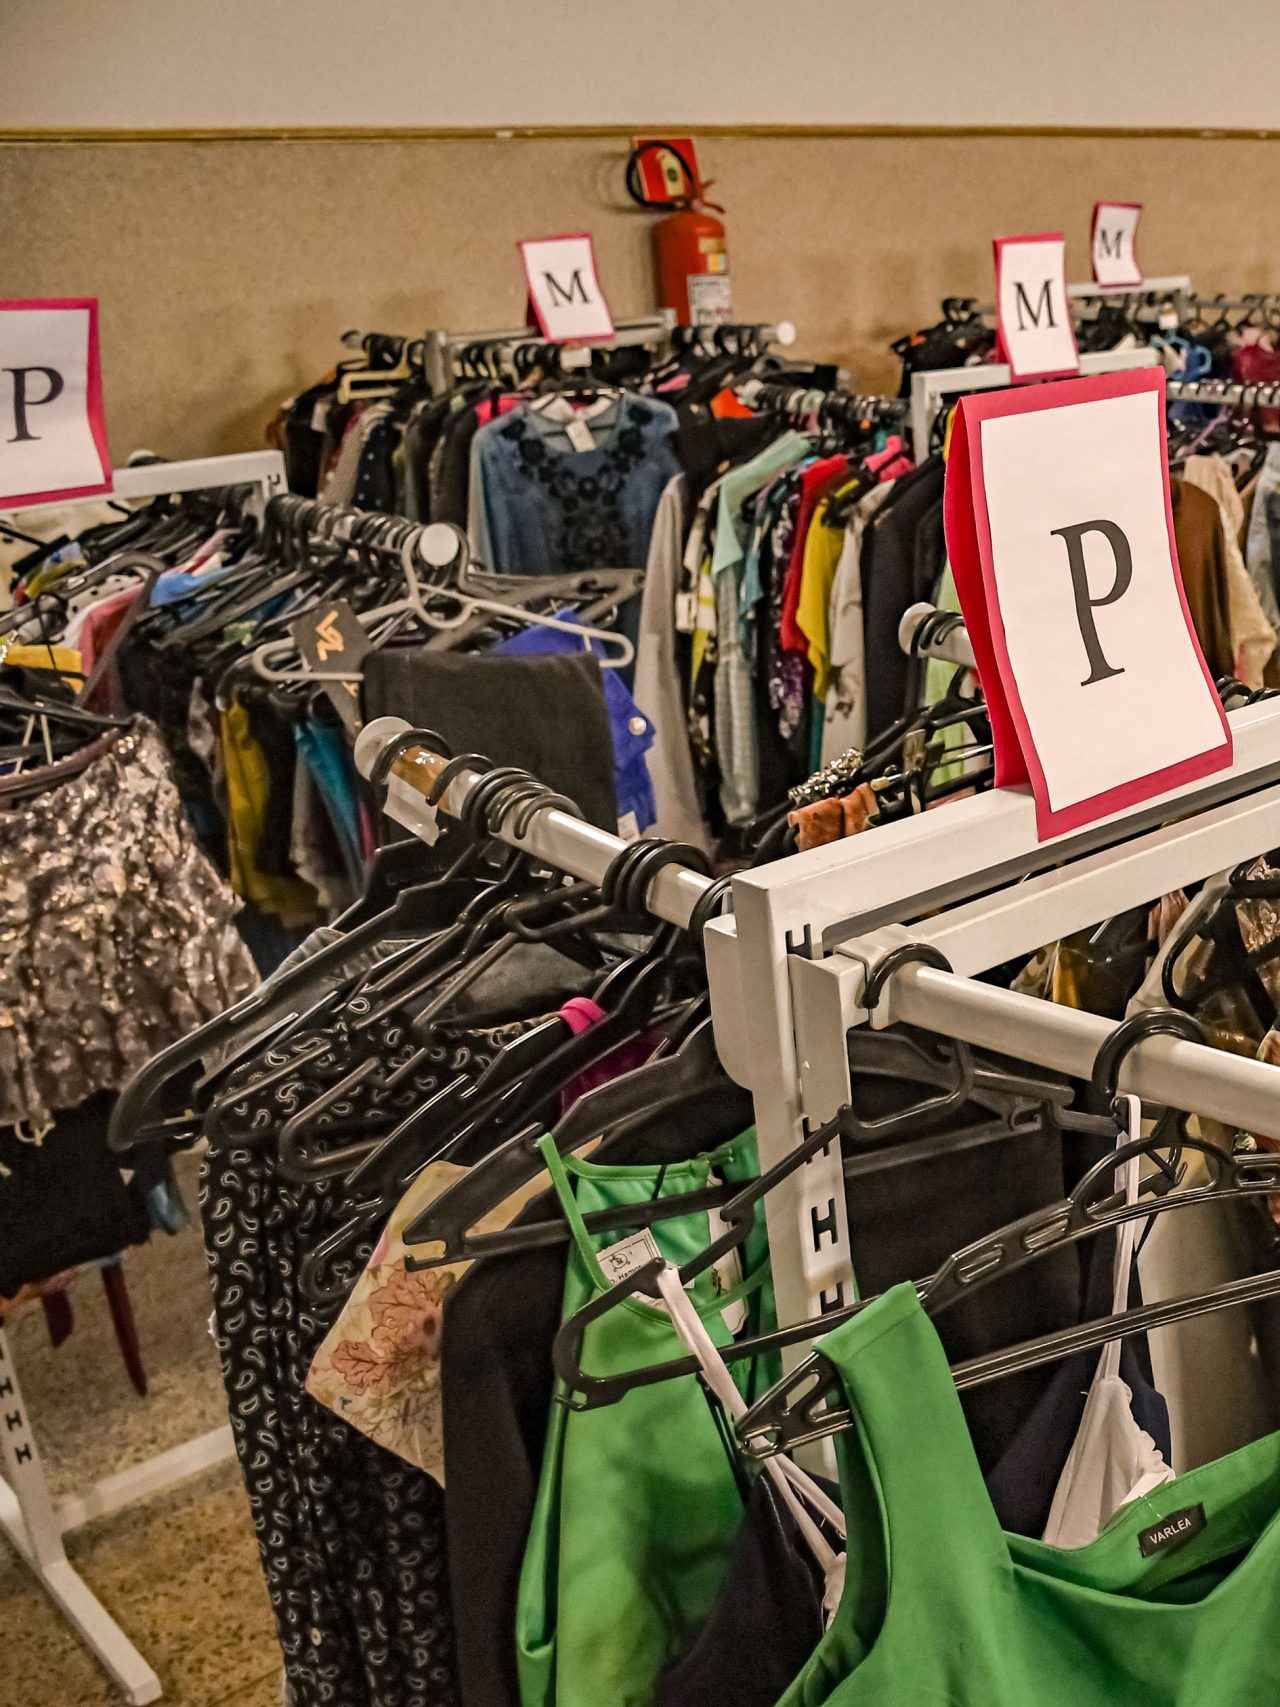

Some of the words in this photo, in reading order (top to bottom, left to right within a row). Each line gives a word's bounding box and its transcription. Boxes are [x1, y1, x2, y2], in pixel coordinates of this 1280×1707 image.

[1098, 228, 1123, 259] M
[542, 270, 590, 307] M
[1013, 279, 1056, 330] M
[2, 366, 64, 443] P
[1050, 519, 1132, 687] P
[1149, 1517, 1192, 1545] VARLEA
